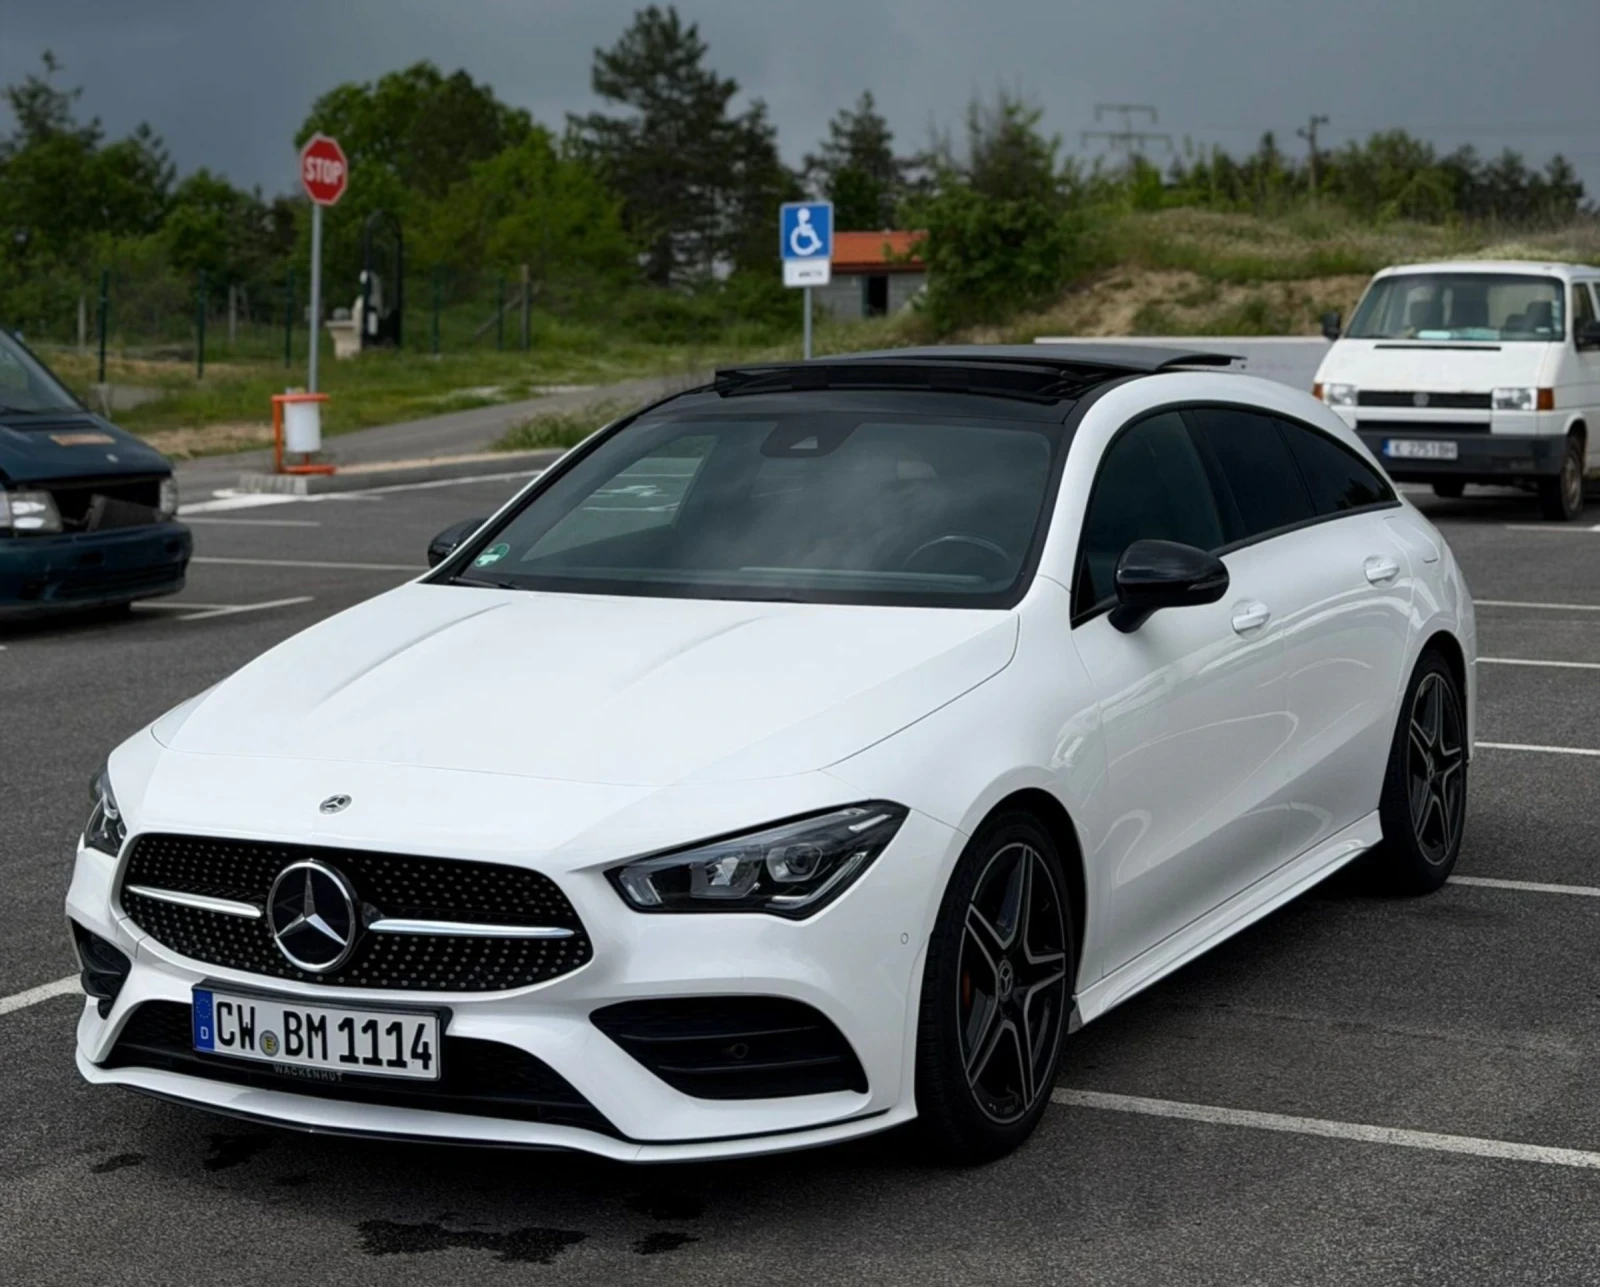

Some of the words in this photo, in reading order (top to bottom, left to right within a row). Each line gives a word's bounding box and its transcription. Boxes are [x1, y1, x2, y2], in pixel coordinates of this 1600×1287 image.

[305, 156, 342, 185] STOP
[201, 1026, 209, 1039] D
[216, 1001, 256, 1051] CW
[283, 1010, 329, 1061] BM
[338, 1017, 432, 1070] 1114
[273, 1063, 343, 1082] WACKENHUT
